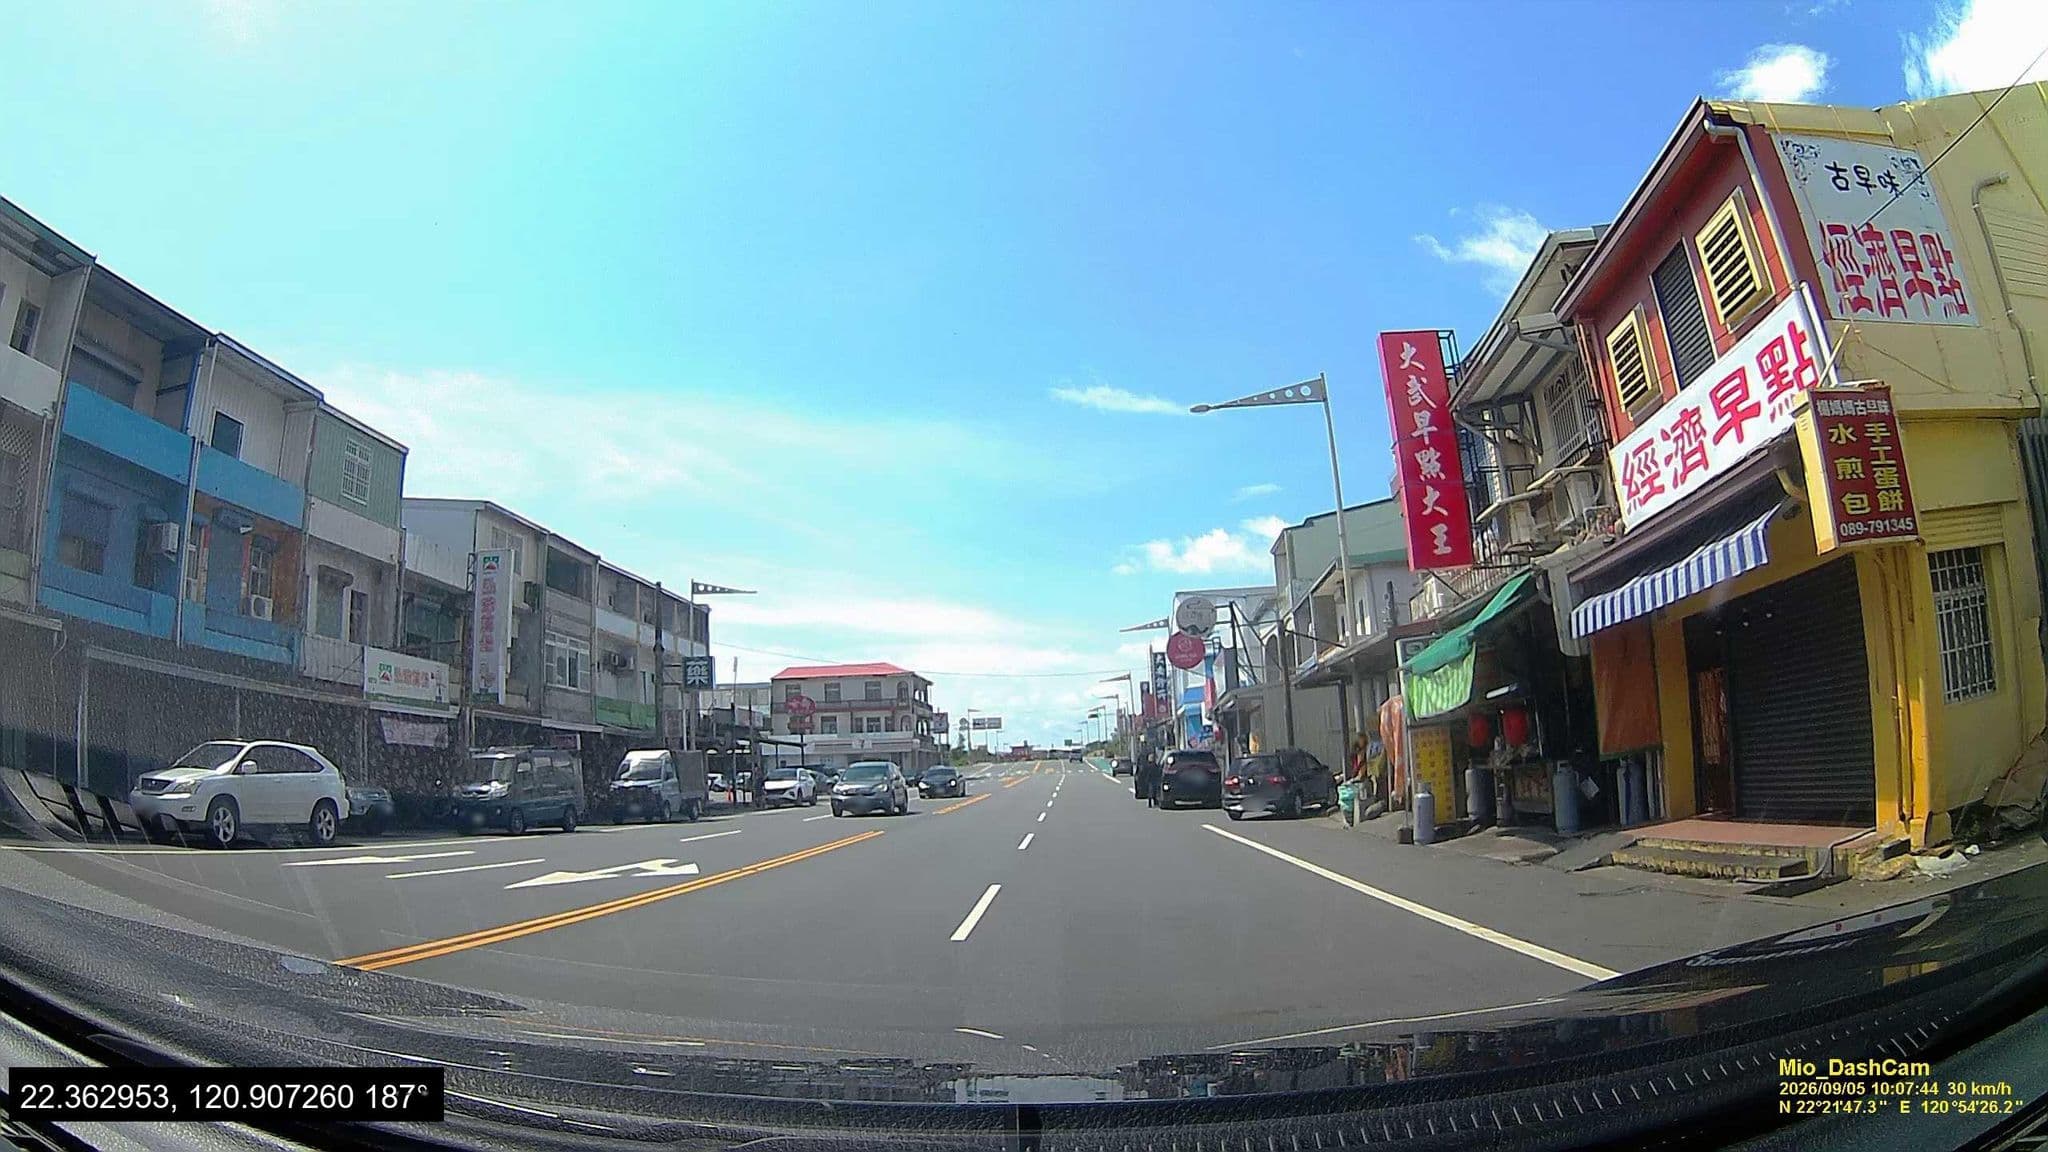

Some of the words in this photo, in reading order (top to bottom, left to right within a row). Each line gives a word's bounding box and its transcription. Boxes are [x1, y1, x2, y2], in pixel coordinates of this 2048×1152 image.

[1825, 161, 1903, 198] 古早味
[1819, 220, 1970, 319] 經濟早點
[1399, 341, 1453, 556] 大武早點大王
[1621, 320, 1820, 516] 經濟早點
[1827, 422, 1872, 516] 水煎包
[1863, 421, 1905, 513] 手工蛋餅
[1839, 517, 1915, 537] 089-791345
[684, 659, 710, 688] 藥
